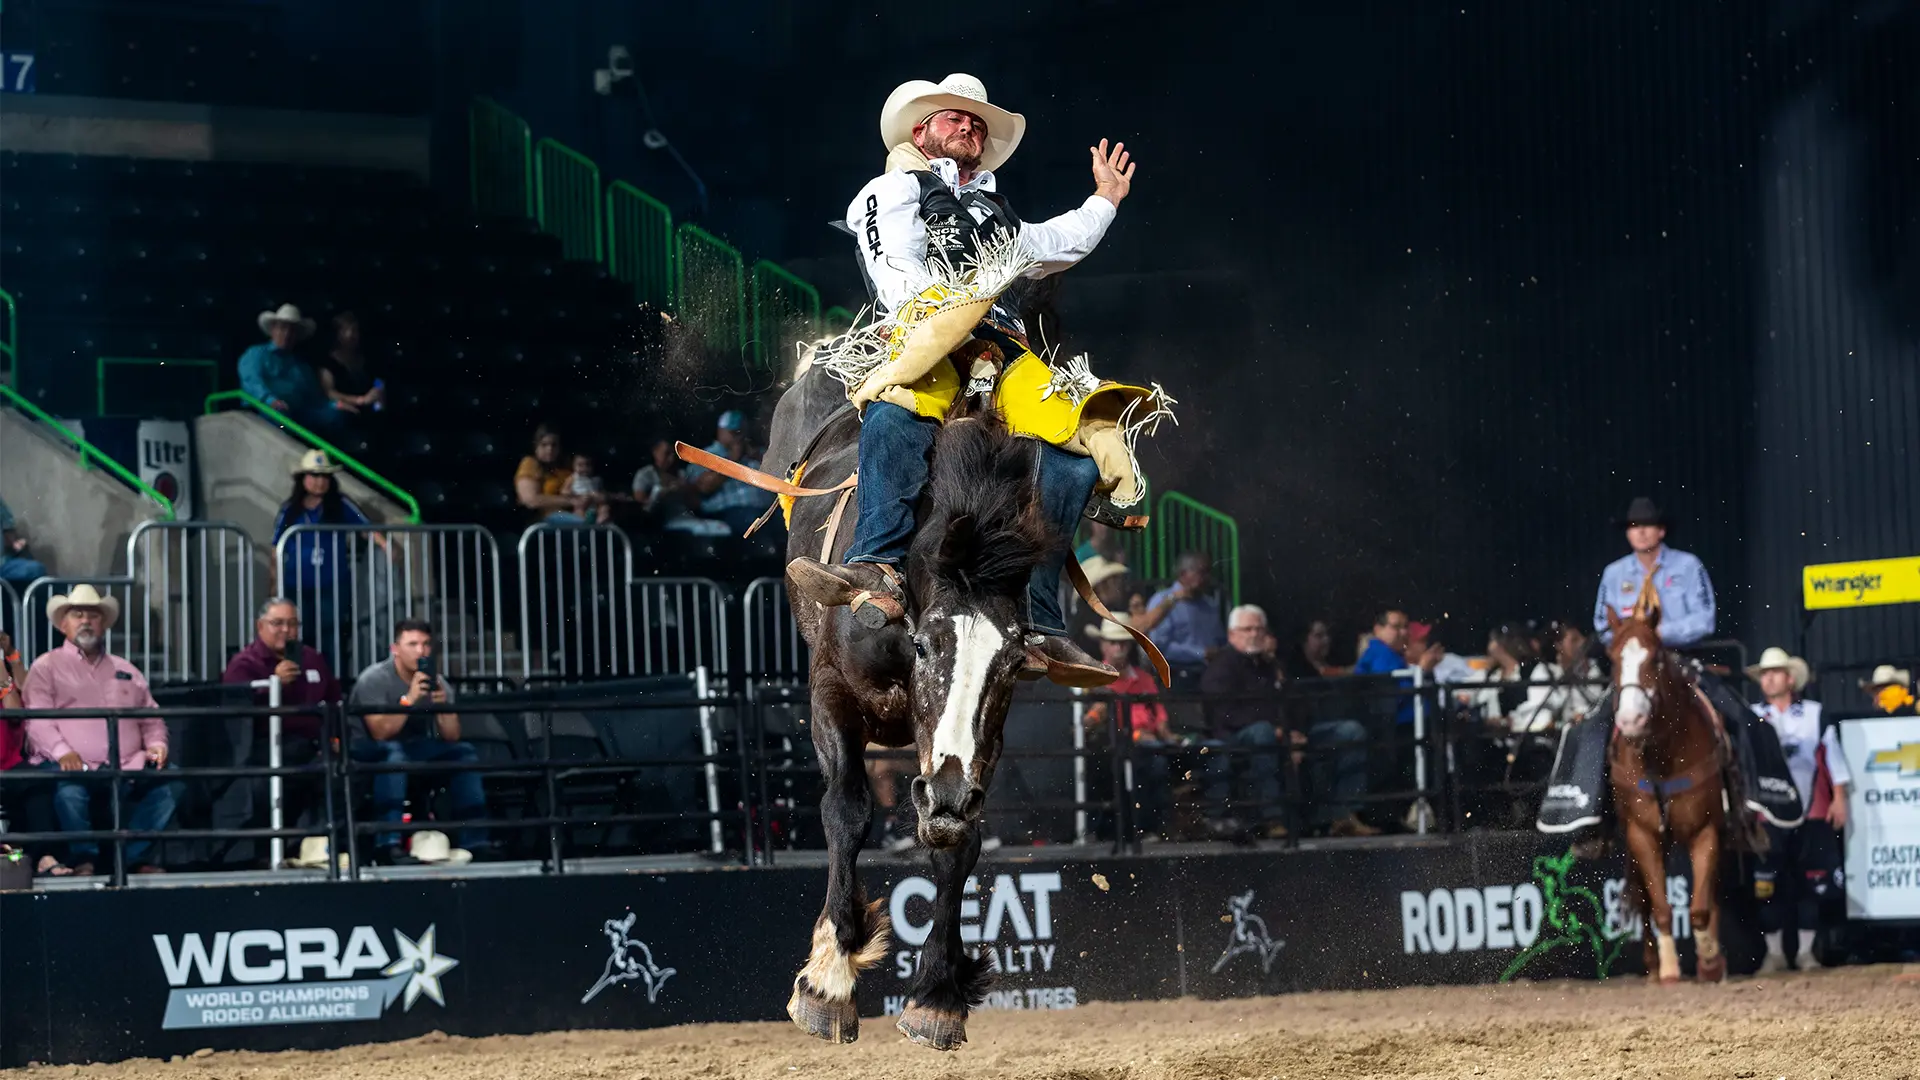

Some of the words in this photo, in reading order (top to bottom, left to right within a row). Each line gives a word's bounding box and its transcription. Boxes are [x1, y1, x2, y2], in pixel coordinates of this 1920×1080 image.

[144, 440, 185, 469] Lite
[1810, 573, 1882, 601] Wrangler
[1867, 867, 1911, 889] CHEVY
[889, 872, 1062, 946] CEAT
[1400, 882, 1543, 953] RODEO
[153, 926, 391, 986] WCRA
[186, 991, 253, 1008] WORLD
[257, 985, 369, 1004] CHAMPIONS
[202, 1006, 263, 1023] RODEO
[269, 1001, 355, 1020] ALLIANCE
